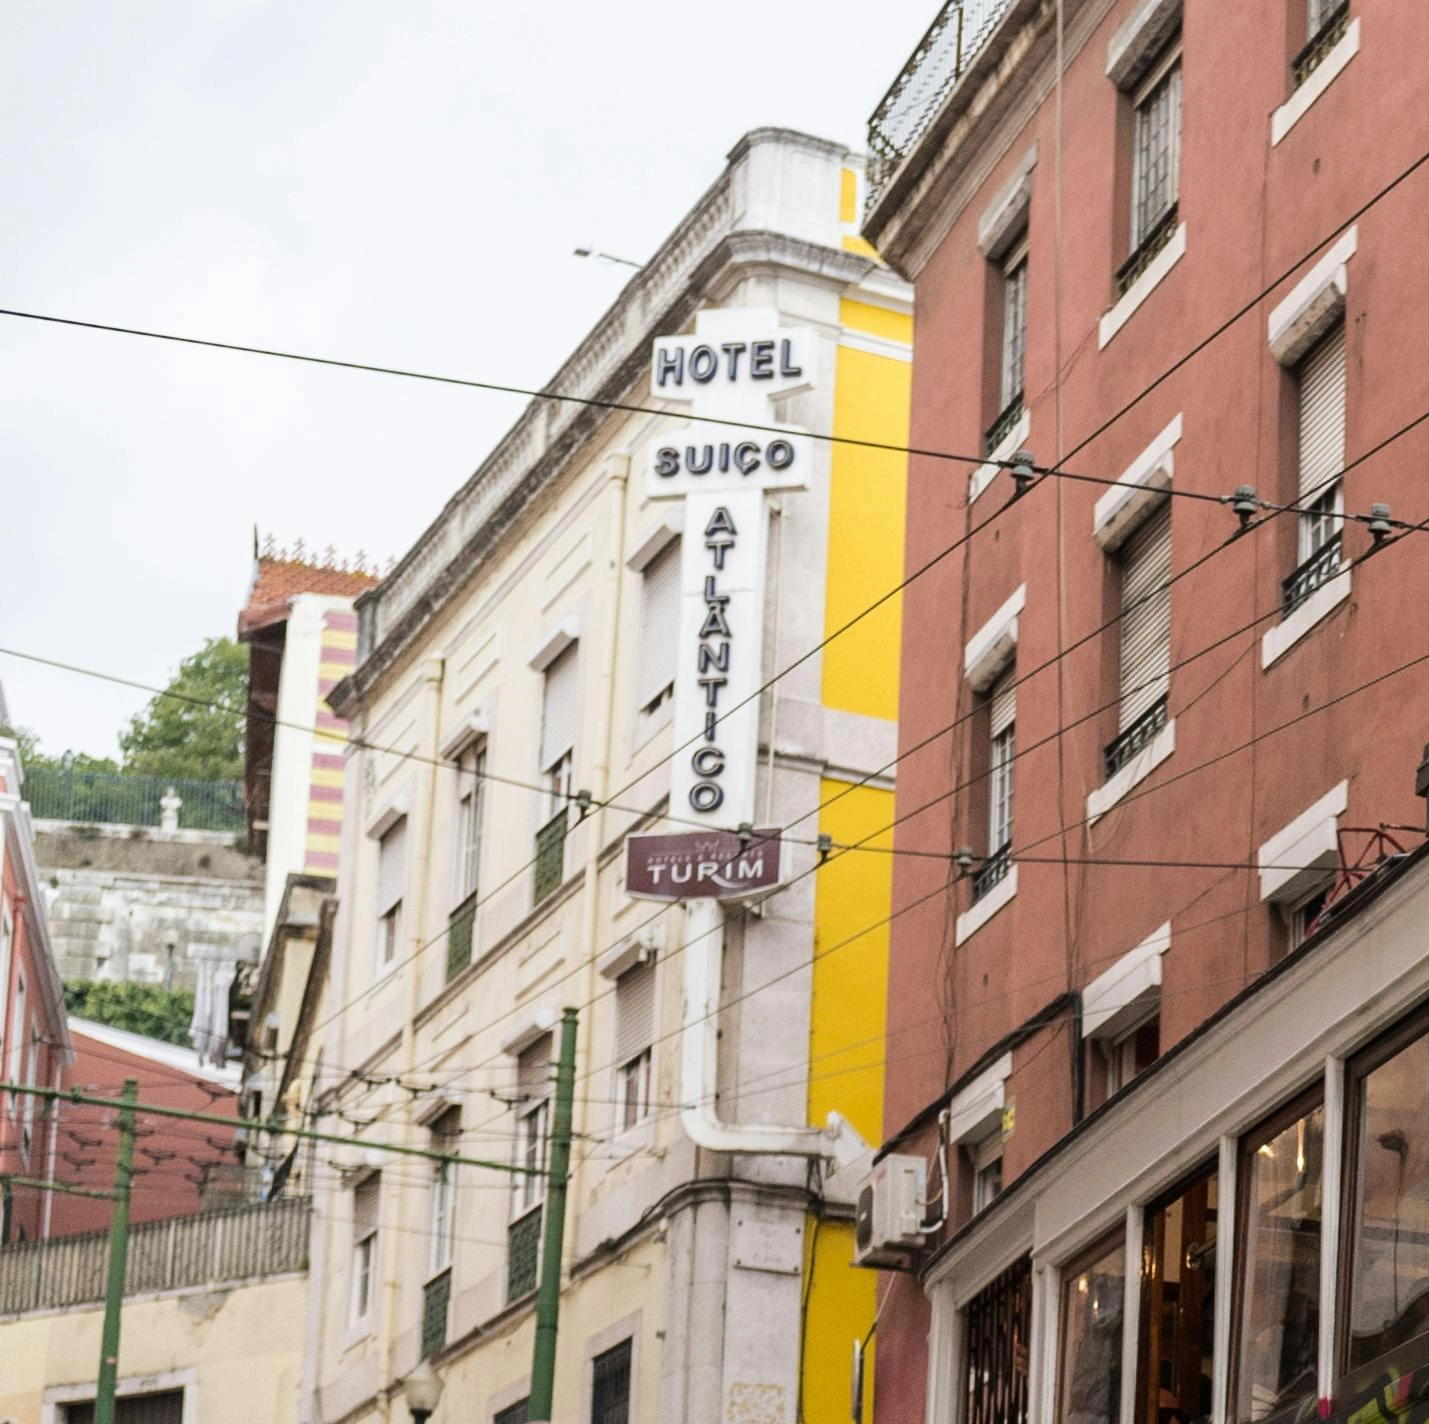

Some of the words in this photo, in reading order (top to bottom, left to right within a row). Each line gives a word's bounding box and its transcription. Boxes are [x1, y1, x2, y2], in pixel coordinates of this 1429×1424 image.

[654, 337, 803, 387] HOTEL
[654, 439, 795, 477] SUIÇO
[688, 505, 738, 813] ATLÂNTICO
[647, 859, 764, 888] TURIM
